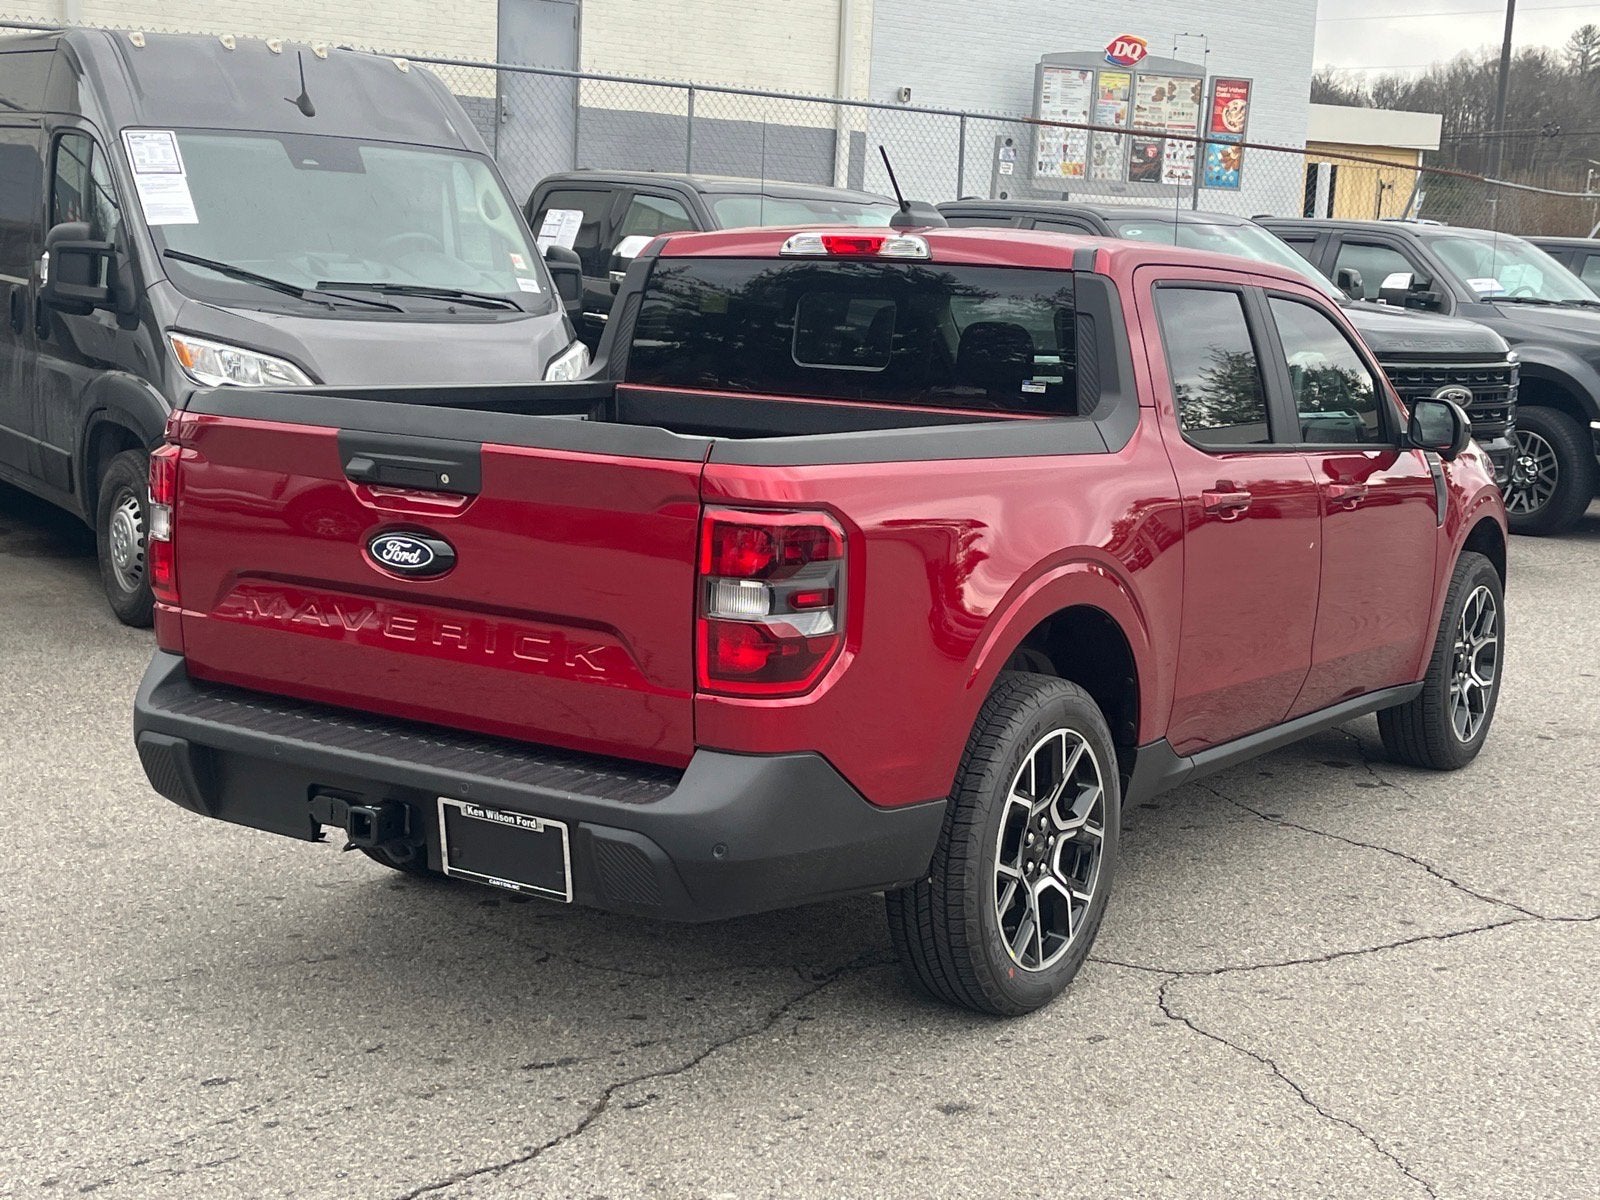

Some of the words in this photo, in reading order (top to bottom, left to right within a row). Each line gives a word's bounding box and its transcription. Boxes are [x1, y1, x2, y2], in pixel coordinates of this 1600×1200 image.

[1113, 41, 1142, 59] DQ
[382, 540, 420, 565] Ford
[245, 594, 606, 672] MAVERICK
[467, 806, 485, 818] Ken
[485, 809, 514, 824] Wilson
[516, 816, 537, 829] Ford
